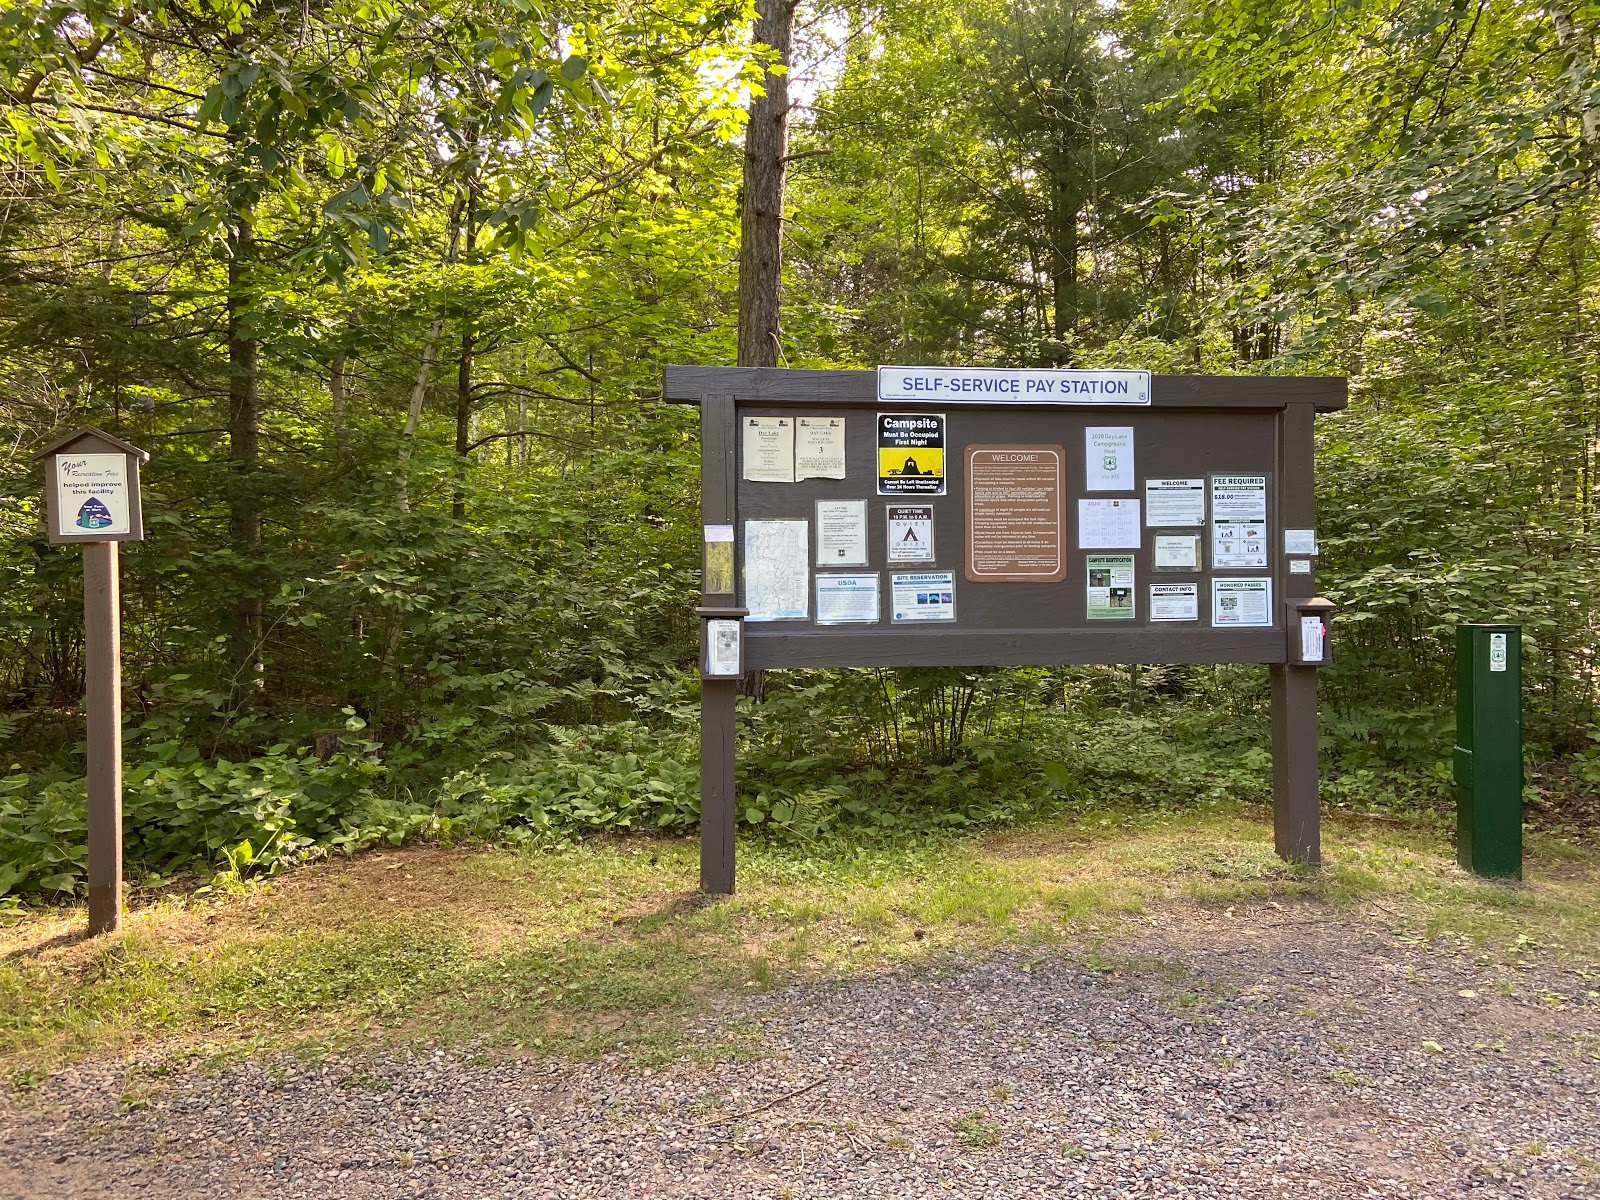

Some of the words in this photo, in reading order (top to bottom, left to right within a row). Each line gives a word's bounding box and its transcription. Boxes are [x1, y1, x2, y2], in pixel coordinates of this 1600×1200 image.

[903, 376, 1020, 393] SELF-SERVICE
[1026, 379, 1056, 393] PAY
[1060, 380, 1128, 394] STATION
[884, 418, 938, 430] Campsite
[62, 460, 87, 476] Your
